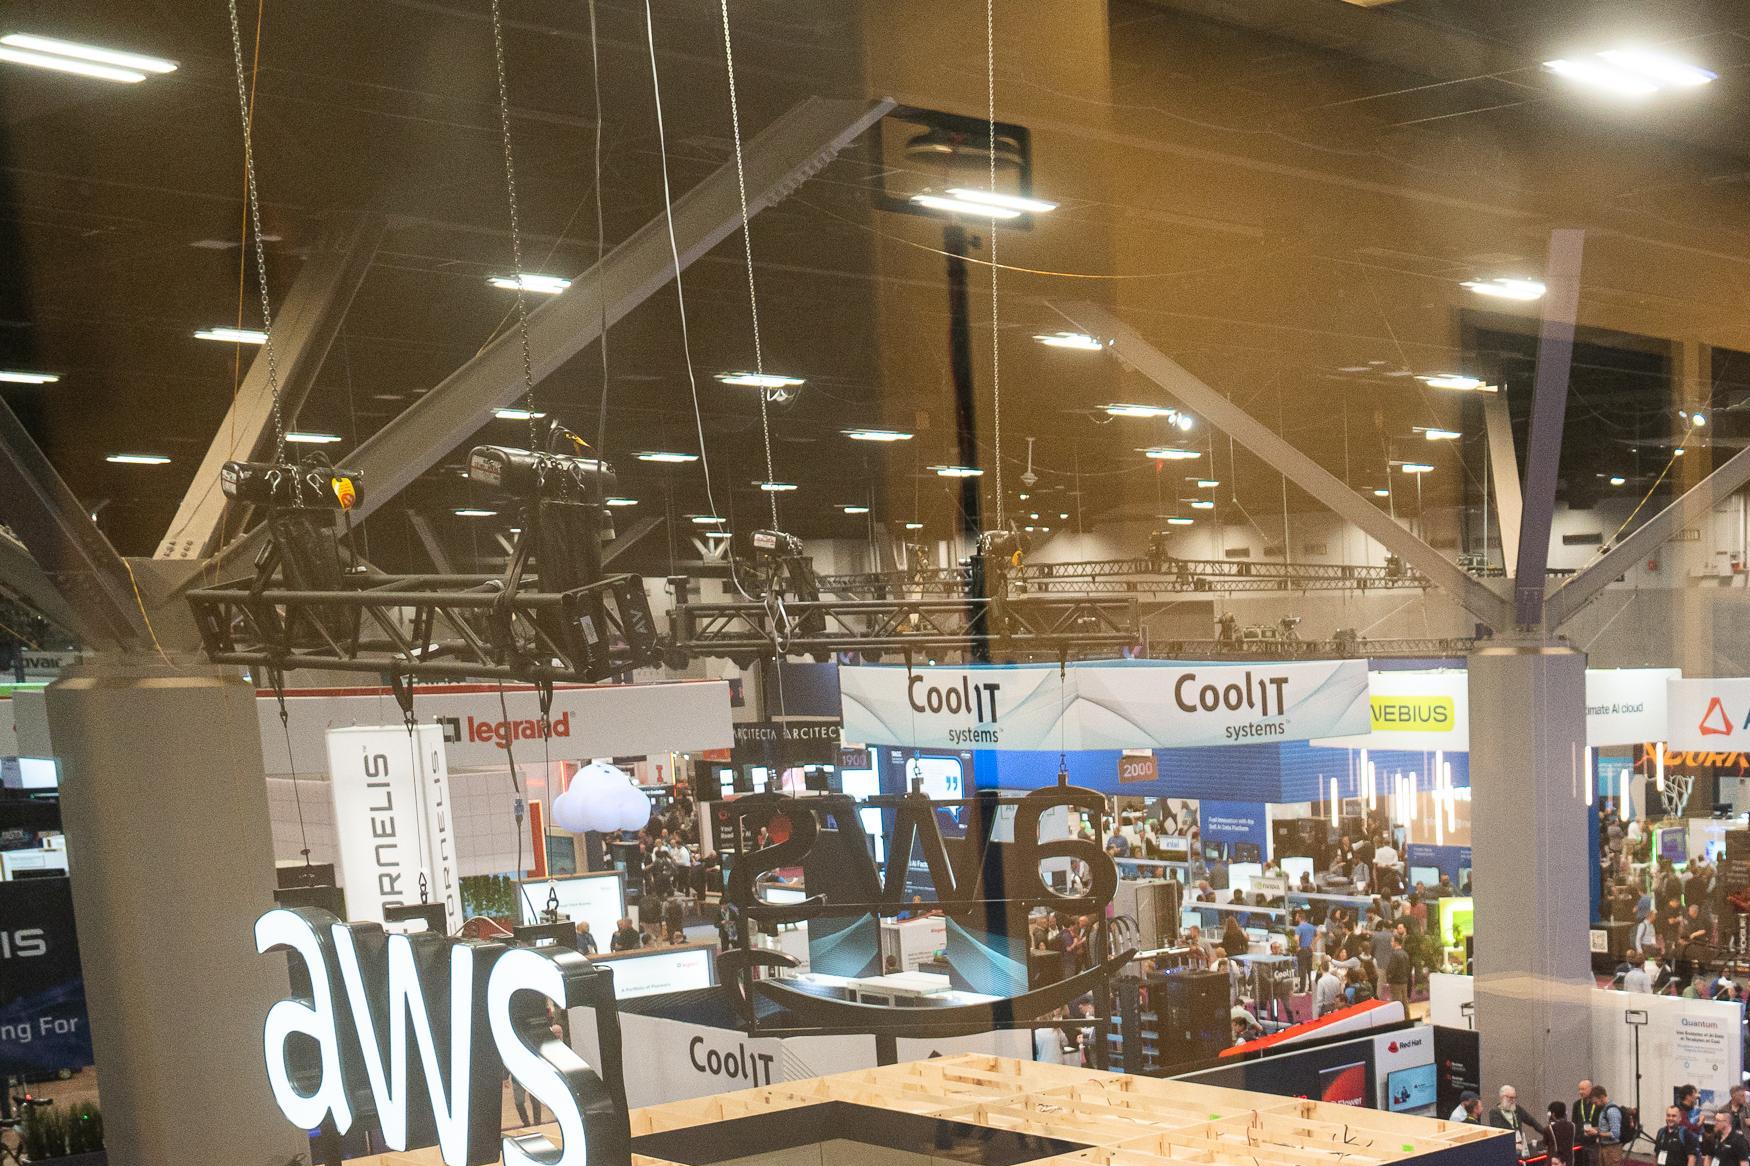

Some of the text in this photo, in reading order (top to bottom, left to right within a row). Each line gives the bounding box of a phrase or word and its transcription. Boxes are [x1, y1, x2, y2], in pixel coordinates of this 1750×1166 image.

[908, 674, 1000, 723] CoolIT
[1174, 671, 1289, 717] CoolIT
[467, 711, 570, 749] legrand
[948, 727, 999, 744] systems
[1225, 721, 1286, 741] systems
[1123, 763, 1154, 777] 2000
[40, 1016, 80, 1036] For
[1681, 1018, 1718, 1029] Quantum
[1399, 1038, 1422, 1049] Red Hat
[689, 1035, 774, 1088] CoolIT
